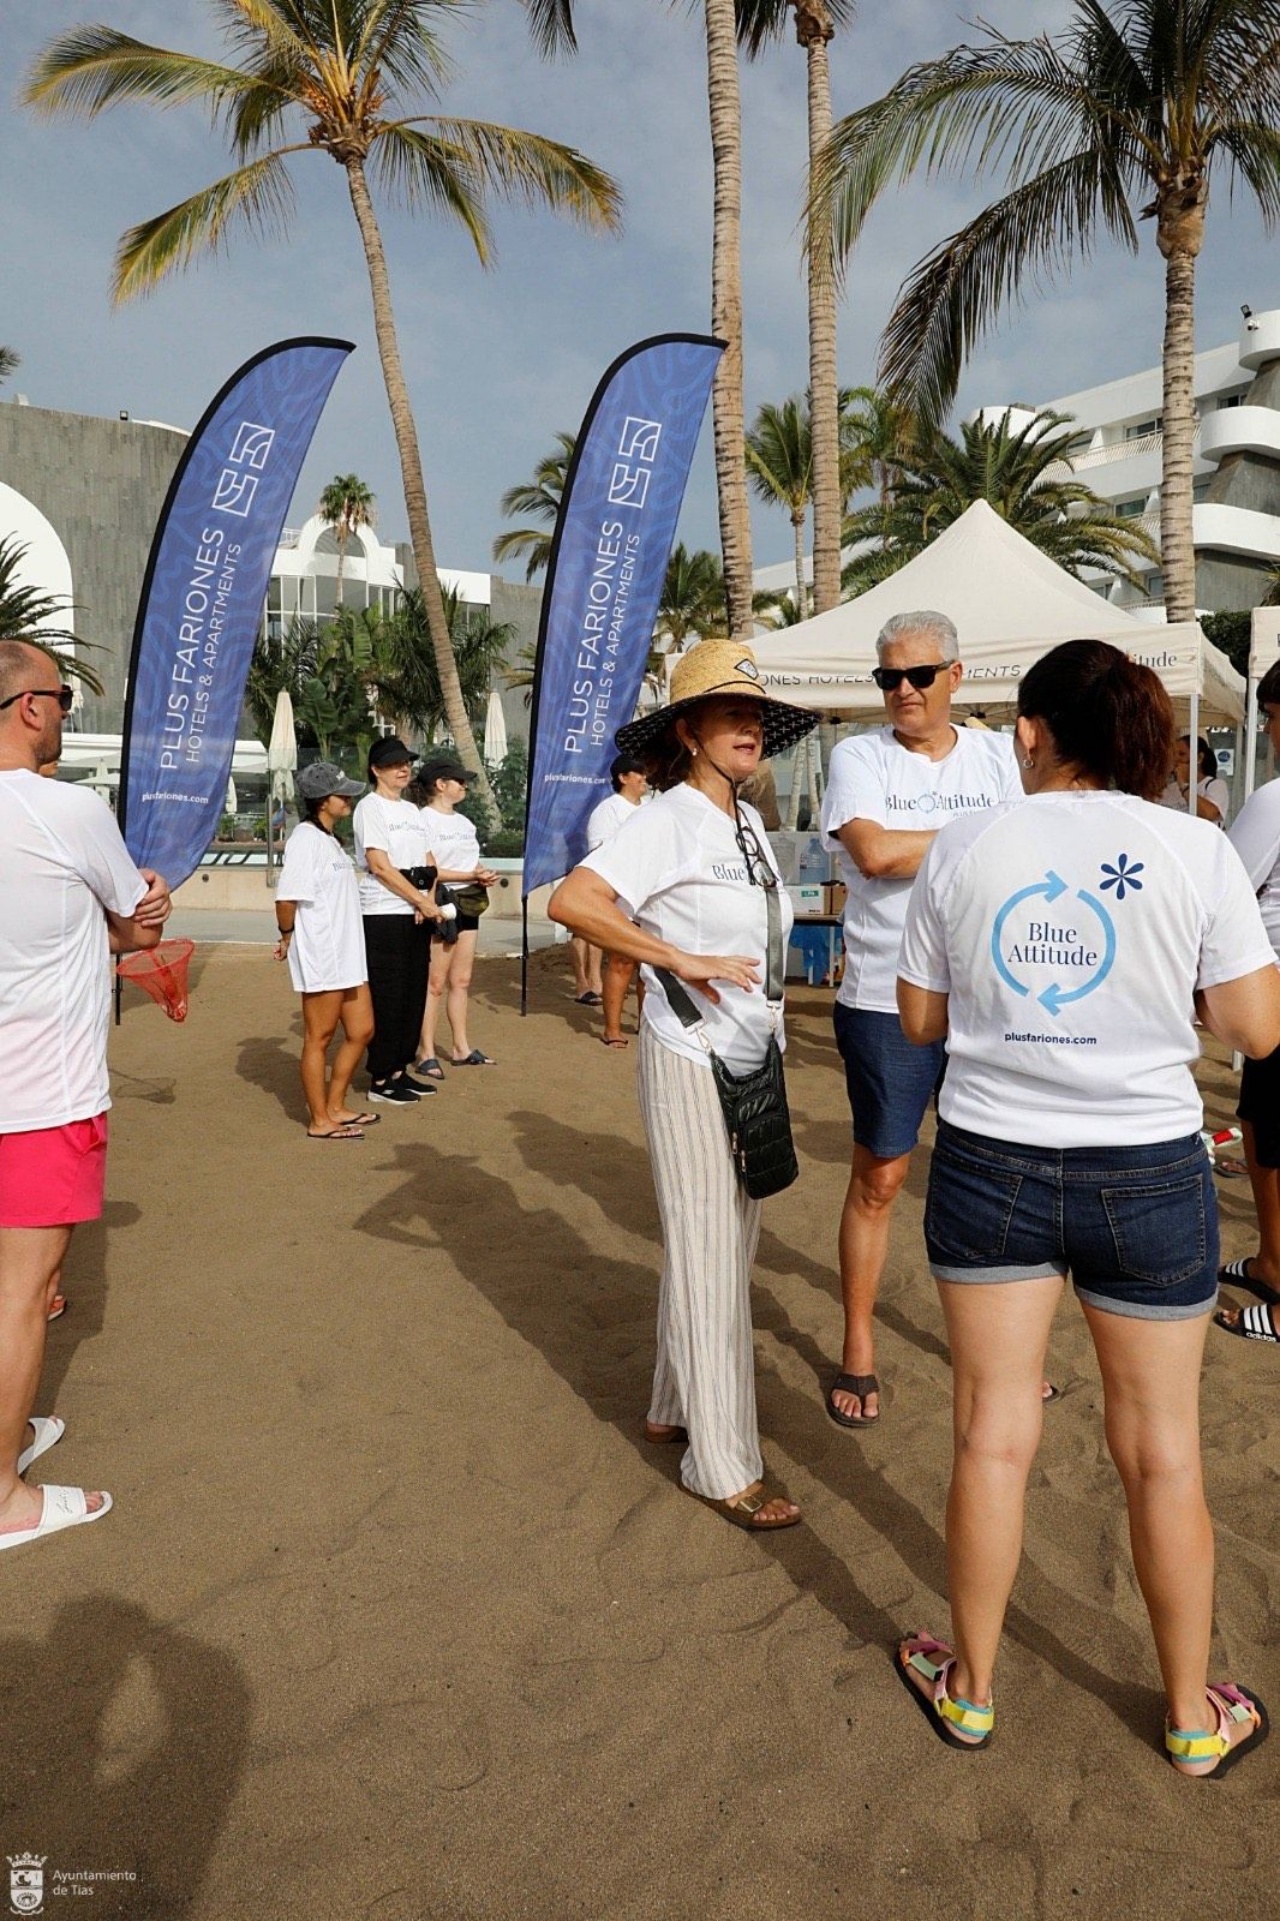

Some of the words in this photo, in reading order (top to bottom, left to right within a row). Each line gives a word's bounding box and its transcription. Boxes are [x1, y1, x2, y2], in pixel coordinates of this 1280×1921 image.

[172, 527, 225, 684] FARIONES
[202, 543, 241, 669] APARTMENTS
[577, 520, 623, 670] FARIONES
[605, 534, 640, 656] APARTMENTS
[198, 675, 213, 687] &
[602, 660, 616, 673] &
[160, 693, 190, 769] PLUS
[185, 692, 210, 763] HOTELS
[564, 680, 593, 753] PLUS
[590, 677, 613, 746] HOTELS
[885, 794, 917, 810] Blue
[712, 863, 745, 881] Blue
[1007, 943, 1098, 966] Attitude
[1028, 922, 1077, 943] Blue
[1004, 1031, 1098, 1045] plusfariones.com
